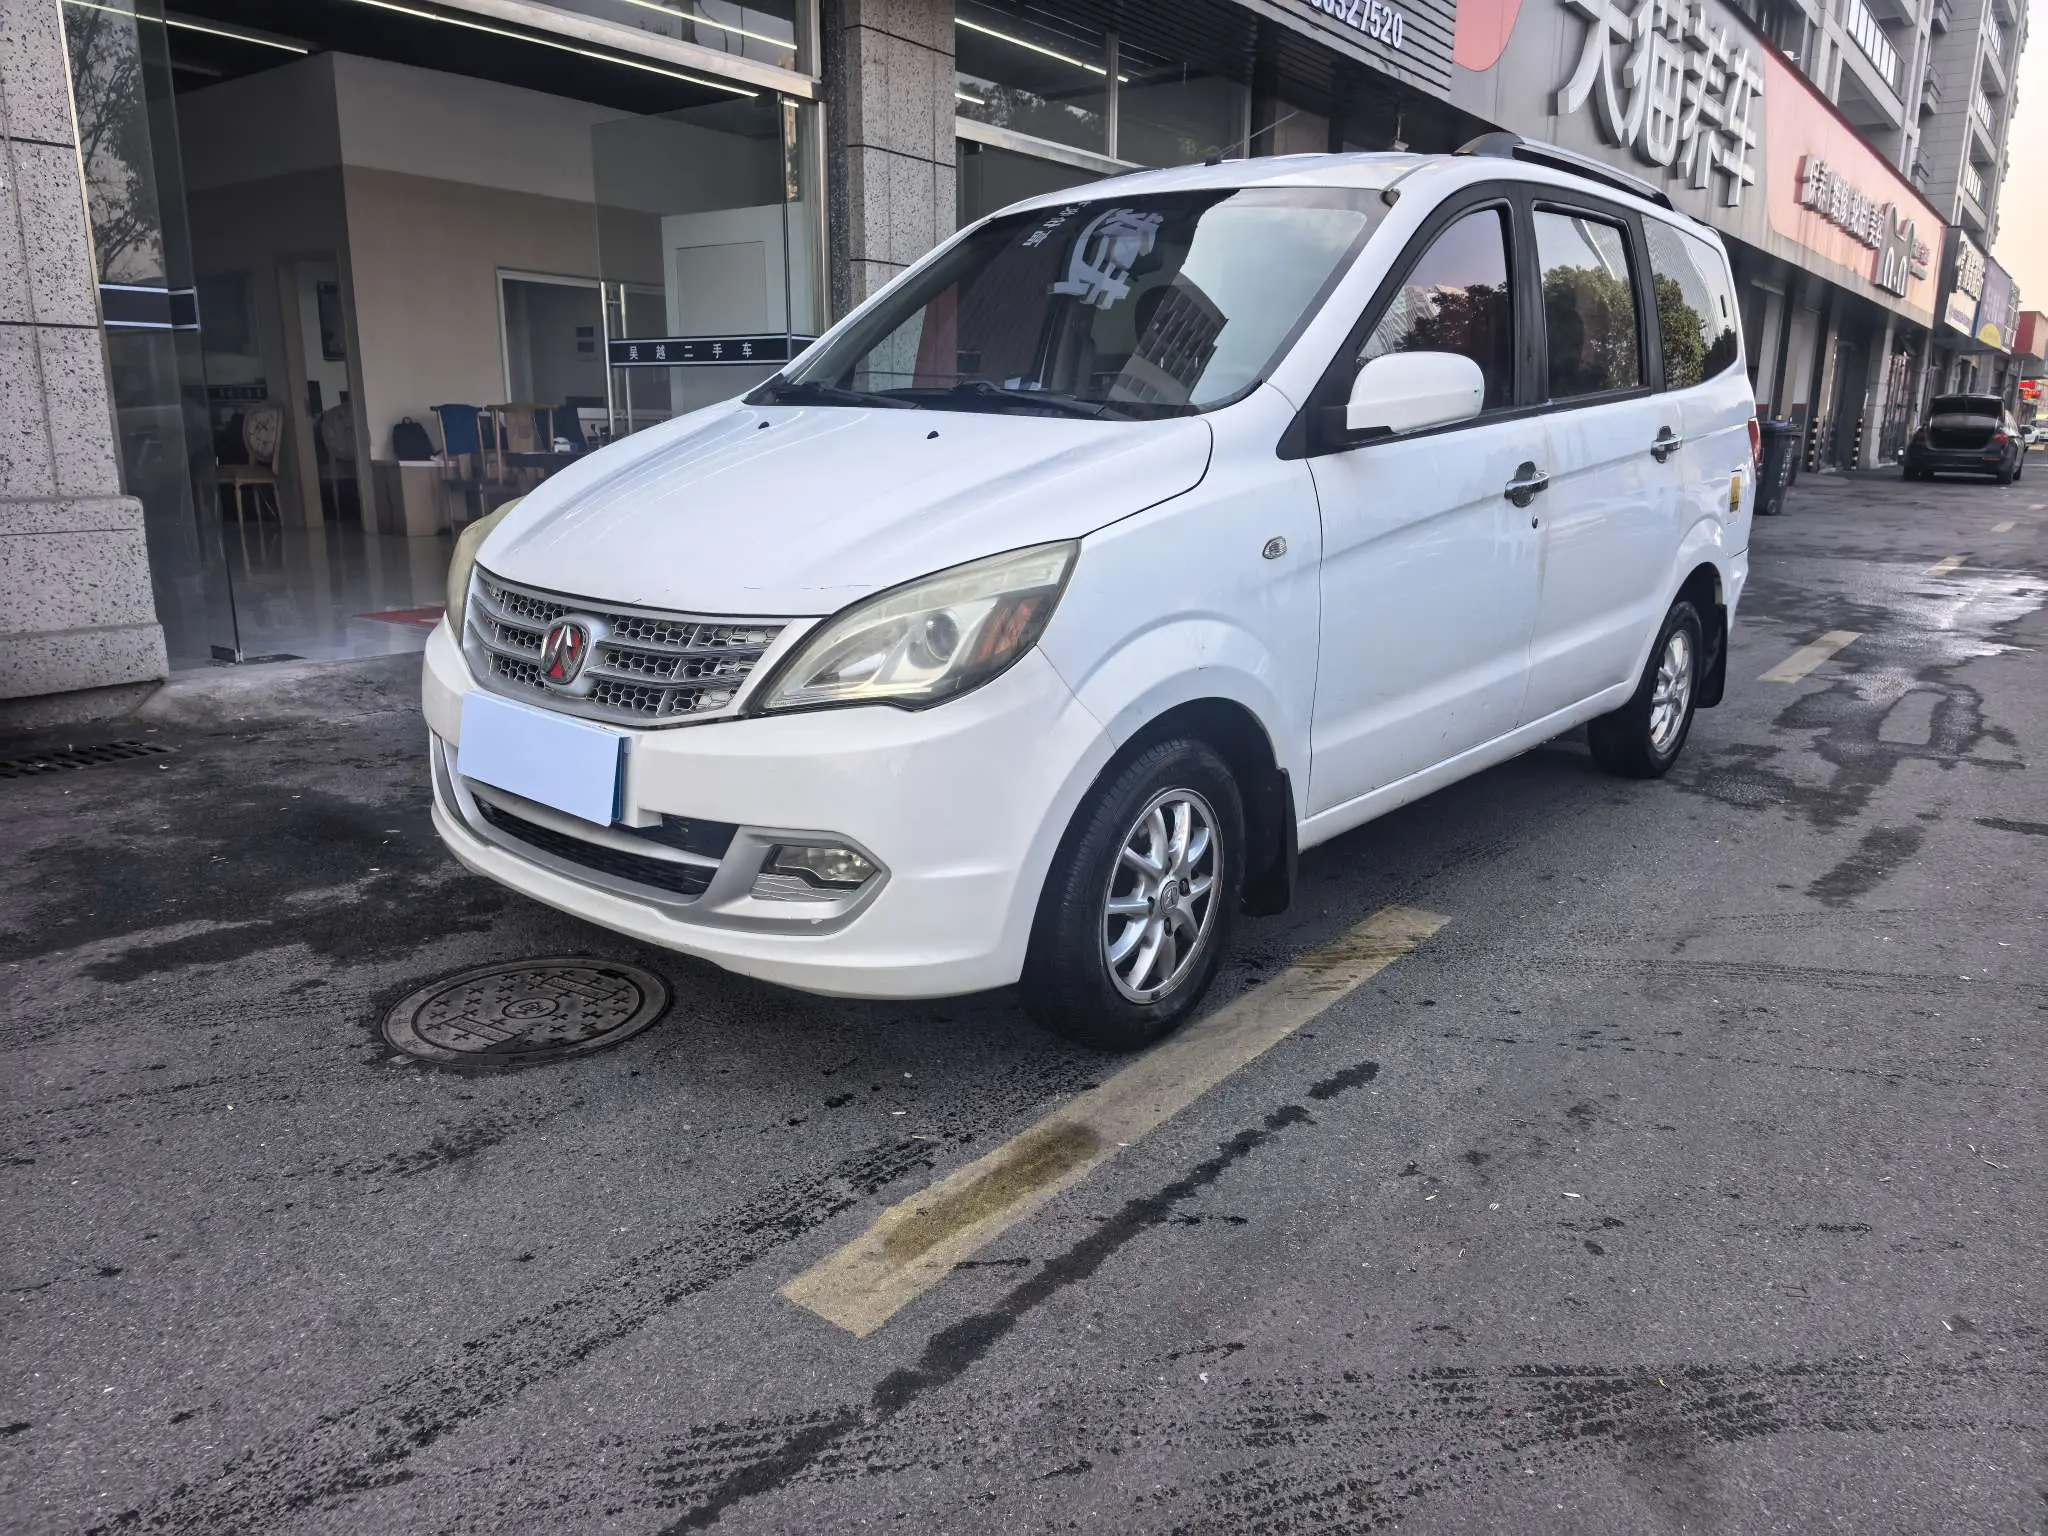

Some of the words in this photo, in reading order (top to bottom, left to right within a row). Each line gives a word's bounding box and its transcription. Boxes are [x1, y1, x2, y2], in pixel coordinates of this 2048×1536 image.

[629, 342, 753, 360] 吴越二手车
